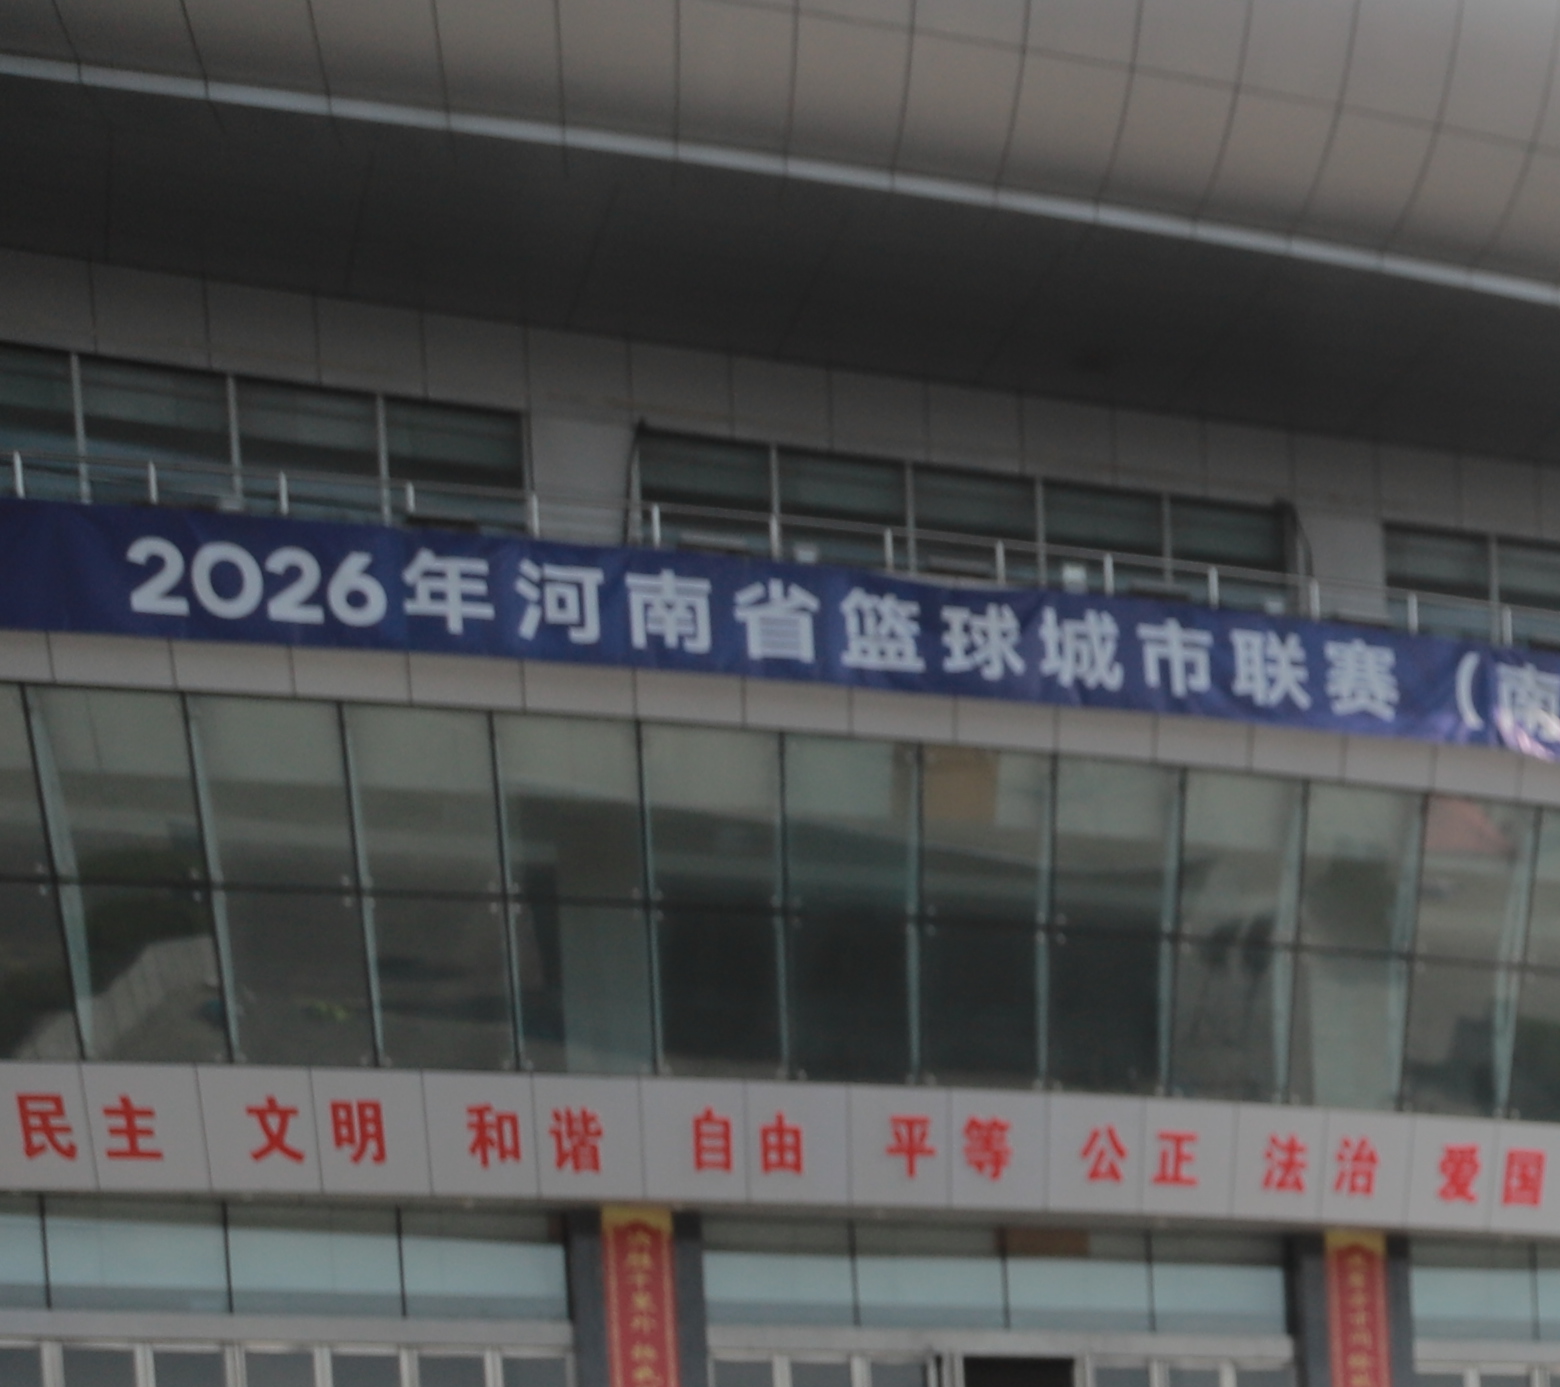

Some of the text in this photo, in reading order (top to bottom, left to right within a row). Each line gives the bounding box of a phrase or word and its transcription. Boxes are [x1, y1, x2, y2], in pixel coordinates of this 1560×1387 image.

[17, 1094, 163, 1161] 民主
[246, 1096, 388, 1164] 文明
[466, 1103, 604, 1174] 和谐
[692, 1107, 805, 1176] 自由
[886, 1115, 1013, 1181] 平等
[1081, 1125, 1199, 1188] 公正
[1262, 1135, 1380, 1196] 法治
[1437, 1143, 1547, 1207] 爱国
